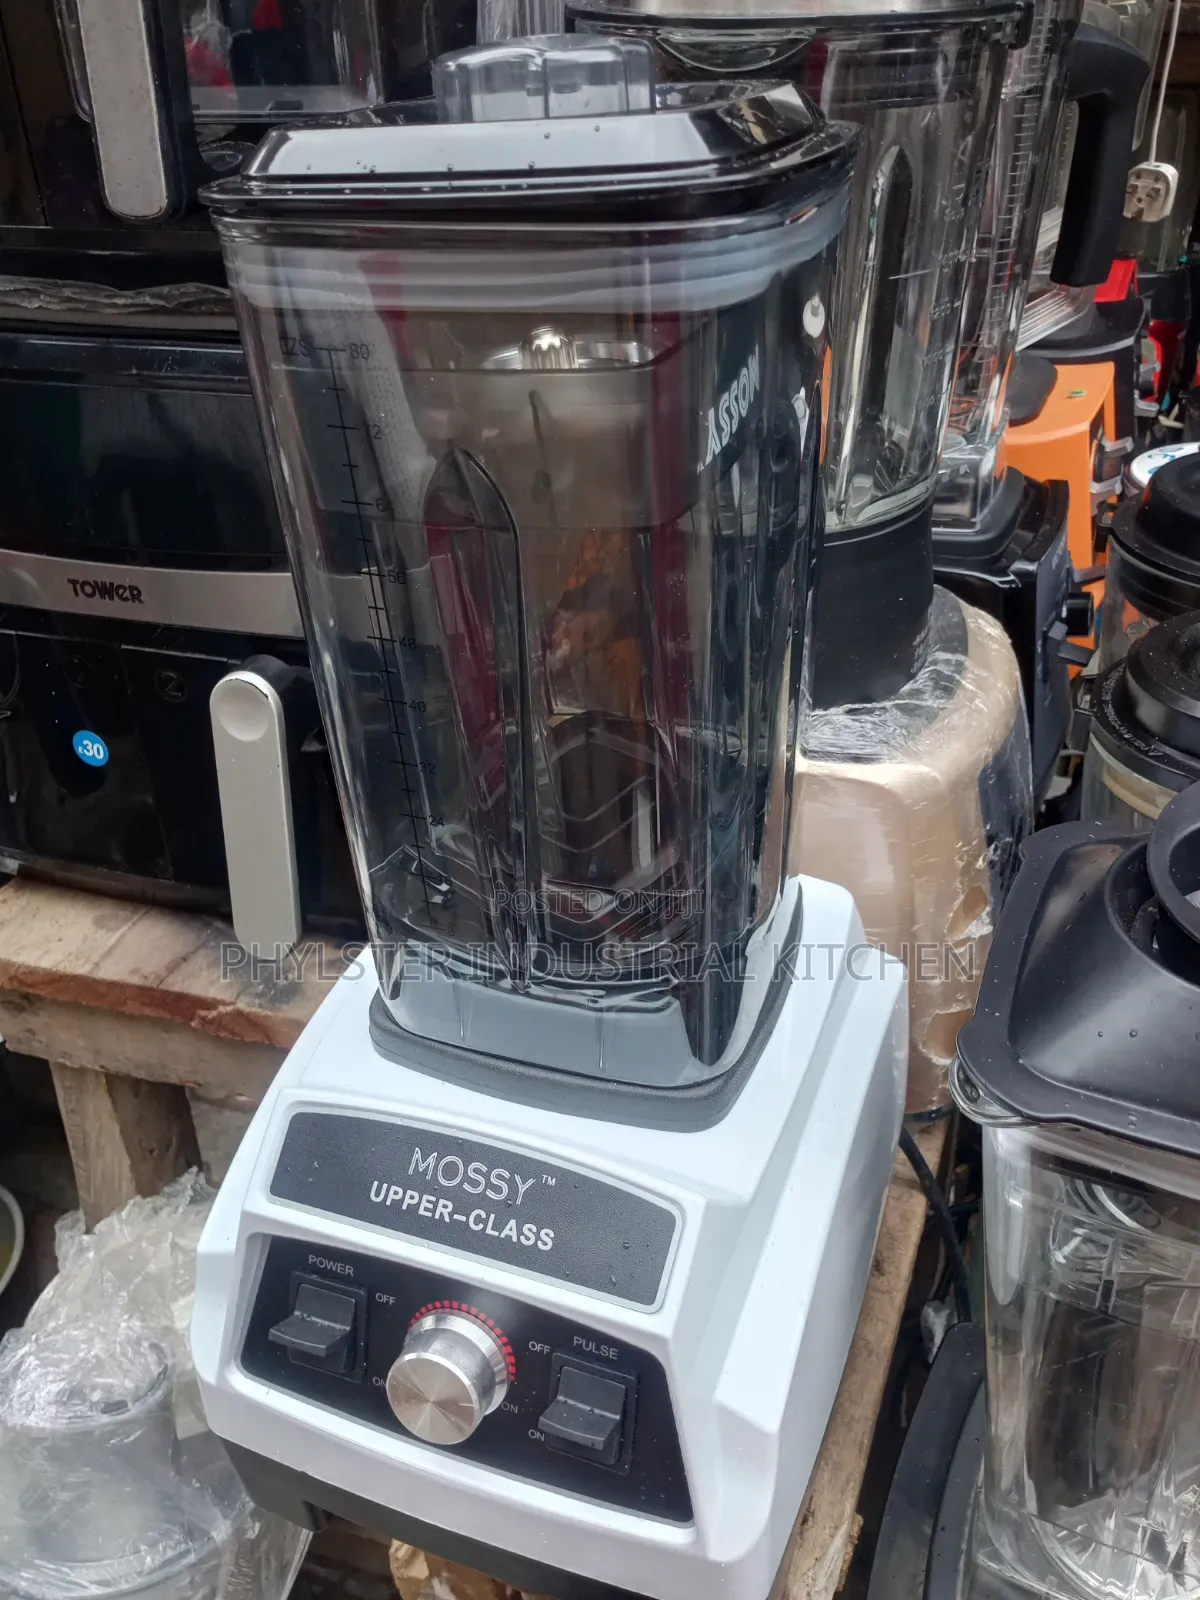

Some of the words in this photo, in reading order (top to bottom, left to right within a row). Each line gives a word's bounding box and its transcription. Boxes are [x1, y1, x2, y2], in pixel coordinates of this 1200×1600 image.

[349, 343, 370, 361] 80
[387, 569, 407, 585] 56
[400, 637, 417, 651] 48
[409, 700, 426, 713] 40
[419, 761, 437, 775] 32
[429, 814, 445, 828] 24
[408, 1147, 536, 1205] MOSSY
[369, 1180, 555, 1251] UPPER-CLASS
[308, 1254, 355, 1277] POWER
[375, 1292, 397, 1306] OFF
[528, 1341, 551, 1355] OFF
[573, 1336, 619, 1360] PULSE
[501, 1401, 519, 1414] ON
[528, 1429, 545, 1442] ON
